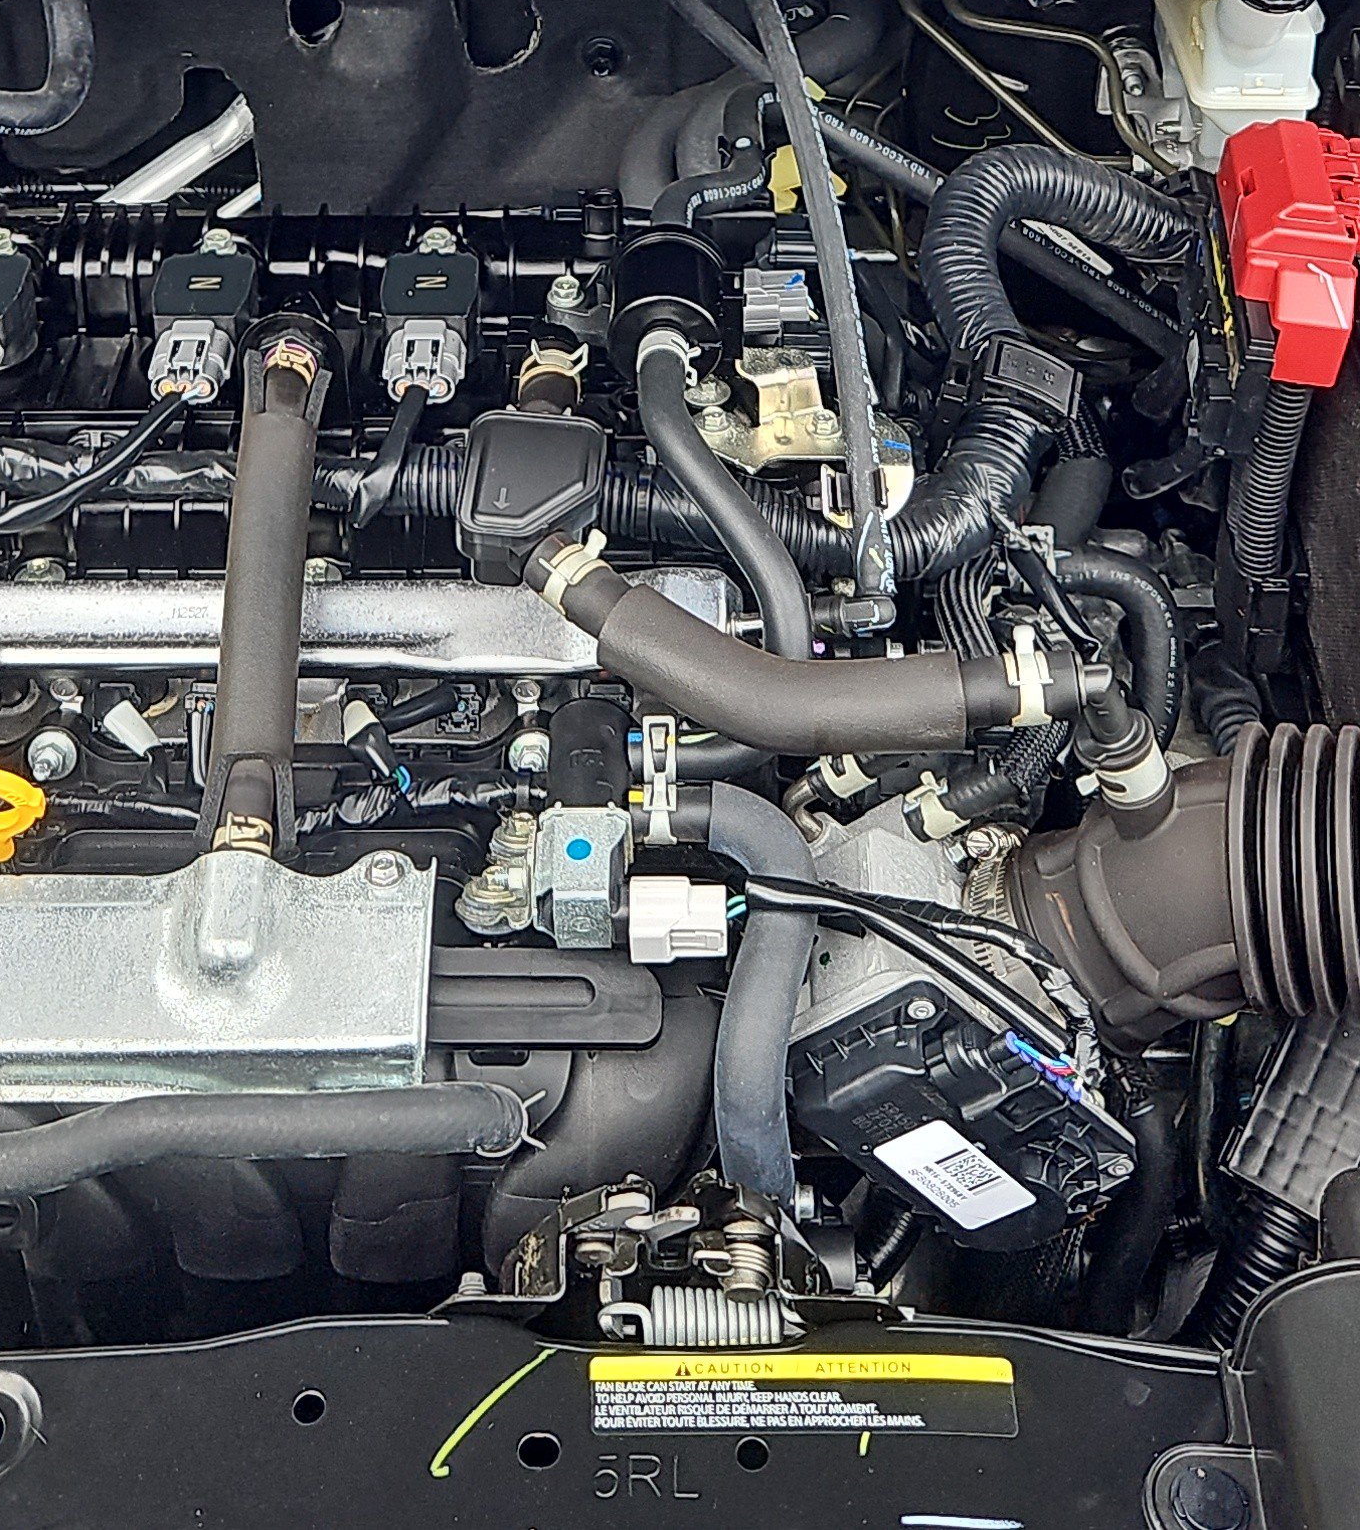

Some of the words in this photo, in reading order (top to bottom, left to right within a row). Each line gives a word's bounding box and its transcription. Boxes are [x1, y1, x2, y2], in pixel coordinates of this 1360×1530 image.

[695, 1363, 773, 1373] CAUTION
[816, 1362, 911, 1372] ATTENTION
[595, 1381, 614, 1391] FAN
[615, 1381, 646, 1391] BLADE
[647, 1381, 667, 1391] CAN
[669, 1381, 696, 1391] START
[698, 1381, 710, 1390] AT
[710, 1381, 731, 1390] ANY
[596, 1393, 609, 1403] TO
[611, 1393, 634, 1403] HELP
[635, 1393, 665, 1402] AVOID
[667, 1393, 714, 1402] PERSONAL
[750, 1392, 773, 1402] KEEP
[775, 1392, 809, 1402] HANDS
[811, 1392, 842, 1402] CLEAR.
[595, 1405, 607, 1415] LE
[608, 1405, 676, 1415] VENTILATEUR
[678, 1404, 714, 1415] RISQUE
[716, 1404, 730, 1414] DE
[732, 1402, 788, 1415] DÉMARRER
[800, 1404, 828, 1414] TOUT
[829, 1404, 879, 1414] MOMENT.
[595, 1417, 626, 1427] POUR
[626, 1415, 661, 1427] ÉVITER
[662, 1417, 695, 1427] TOUTE
[697, 1417, 750, 1428] BLESSURE,
[750, 1417, 765, 1427] NE
[766, 1416, 786, 1426] PAS
[788, 1416, 803, 1426] EN
[805, 1416, 866, 1426] APPROCHER
[868, 1416, 885, 1426] LES
[886, 1416, 926, 1426] MAINS.
[594, 1455, 700, 1498] 5RL
